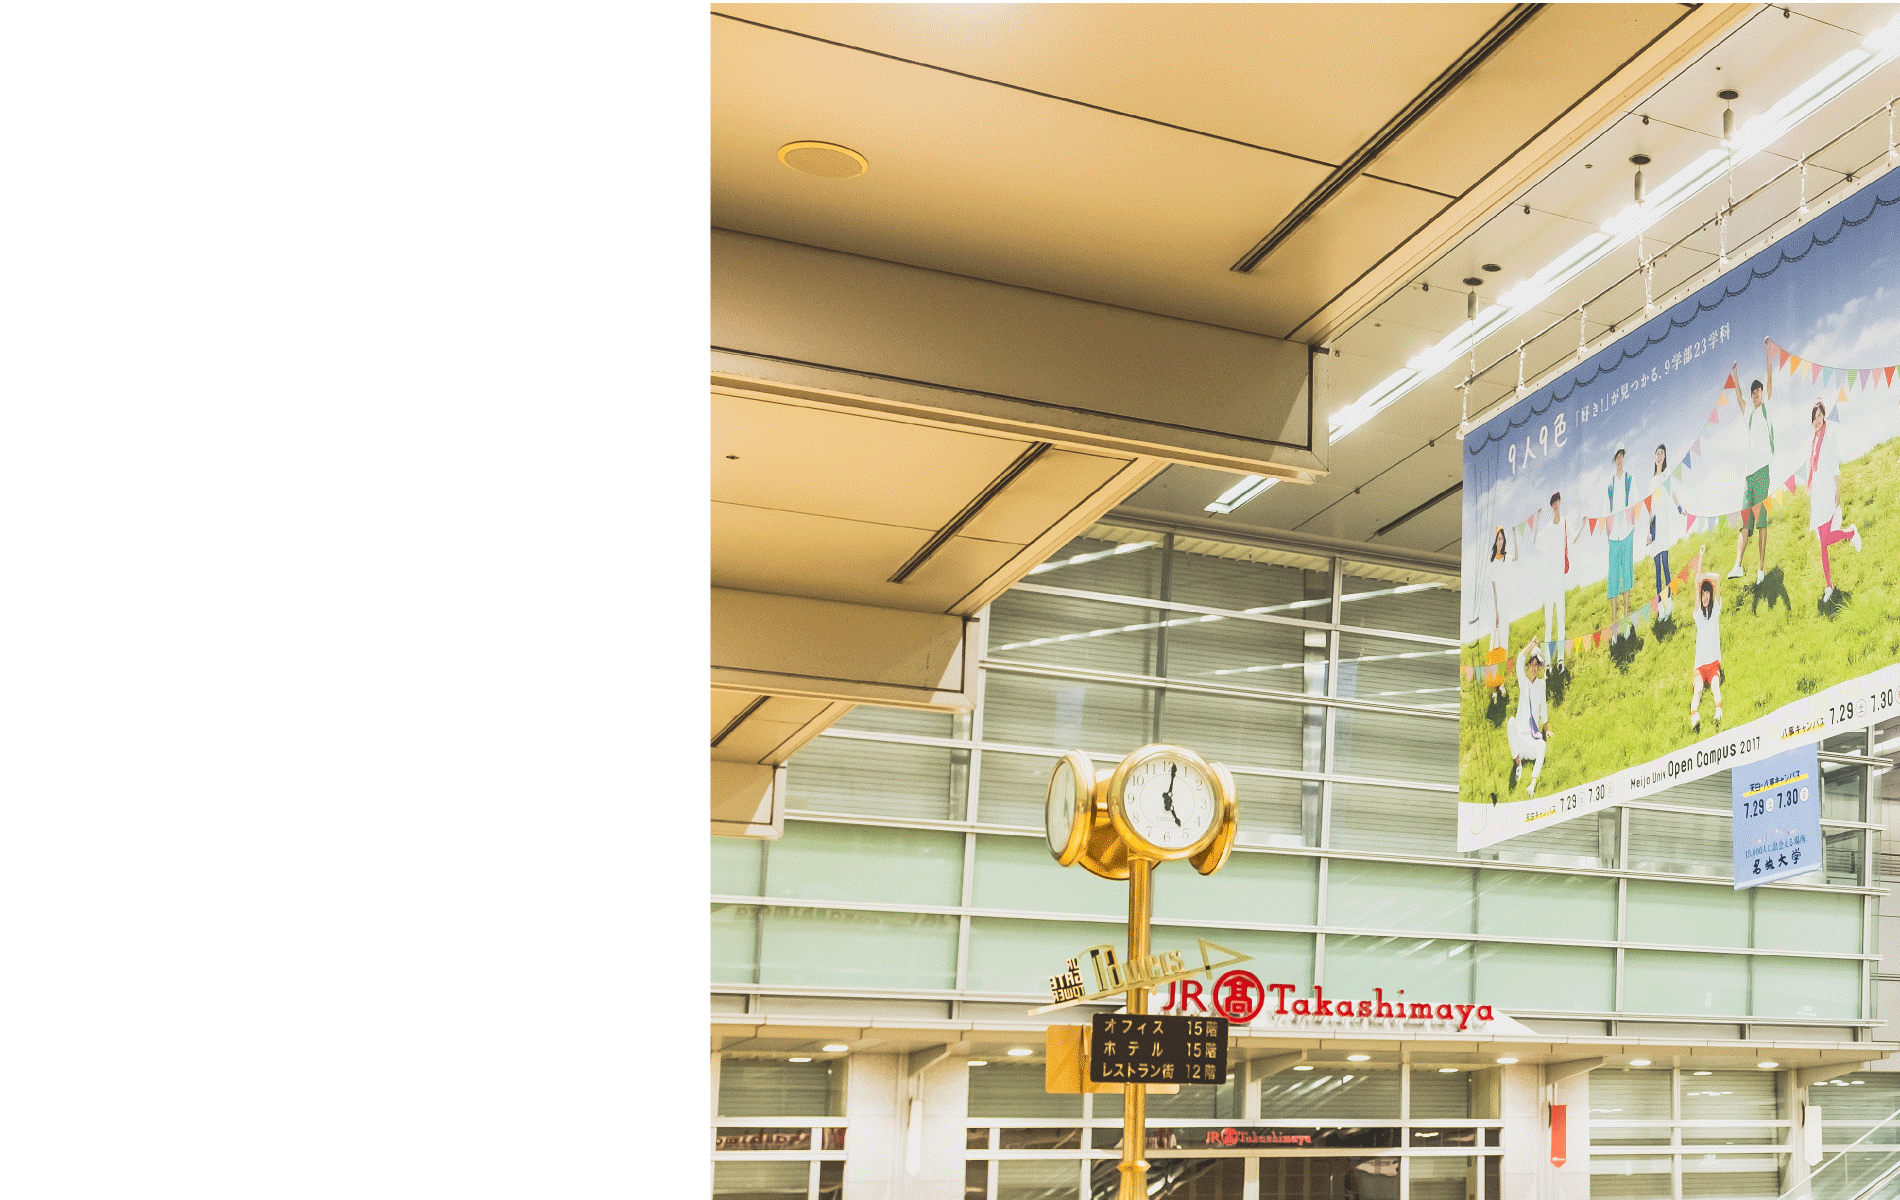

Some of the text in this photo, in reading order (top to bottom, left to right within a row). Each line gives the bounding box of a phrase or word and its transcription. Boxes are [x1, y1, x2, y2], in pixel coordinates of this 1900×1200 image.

[1508, 412, 1568, 475] 9人9色
[1830, 702, 1853, 724] 7.29
[1871, 689, 1893, 712] 7.30
[1145, 763, 1156, 775] 11
[1631, 776, 1651, 789] Meijo
[1668, 757, 1693, 779] Open
[1696, 743, 1737, 768] Campus
[1740, 736, 1760, 754] 2017
[1132, 775, 1144, 786] 10
[1196, 780, 1203, 791] 2
[1128, 792, 1135, 804] 9
[1560, 794, 1577, 813] 7.29
[1588, 784, 1605, 803] 7.30
[1744, 799, 1764, 819] 7.29
[1777, 788, 1798, 809] 7.30
[1163, 980, 1207, 1012] JR
[1268, 982, 1494, 1030] Takashimaya
[1104, 1019, 1164, 1035] オフィス
[1102, 1062, 1175, 1079] レストラン街
